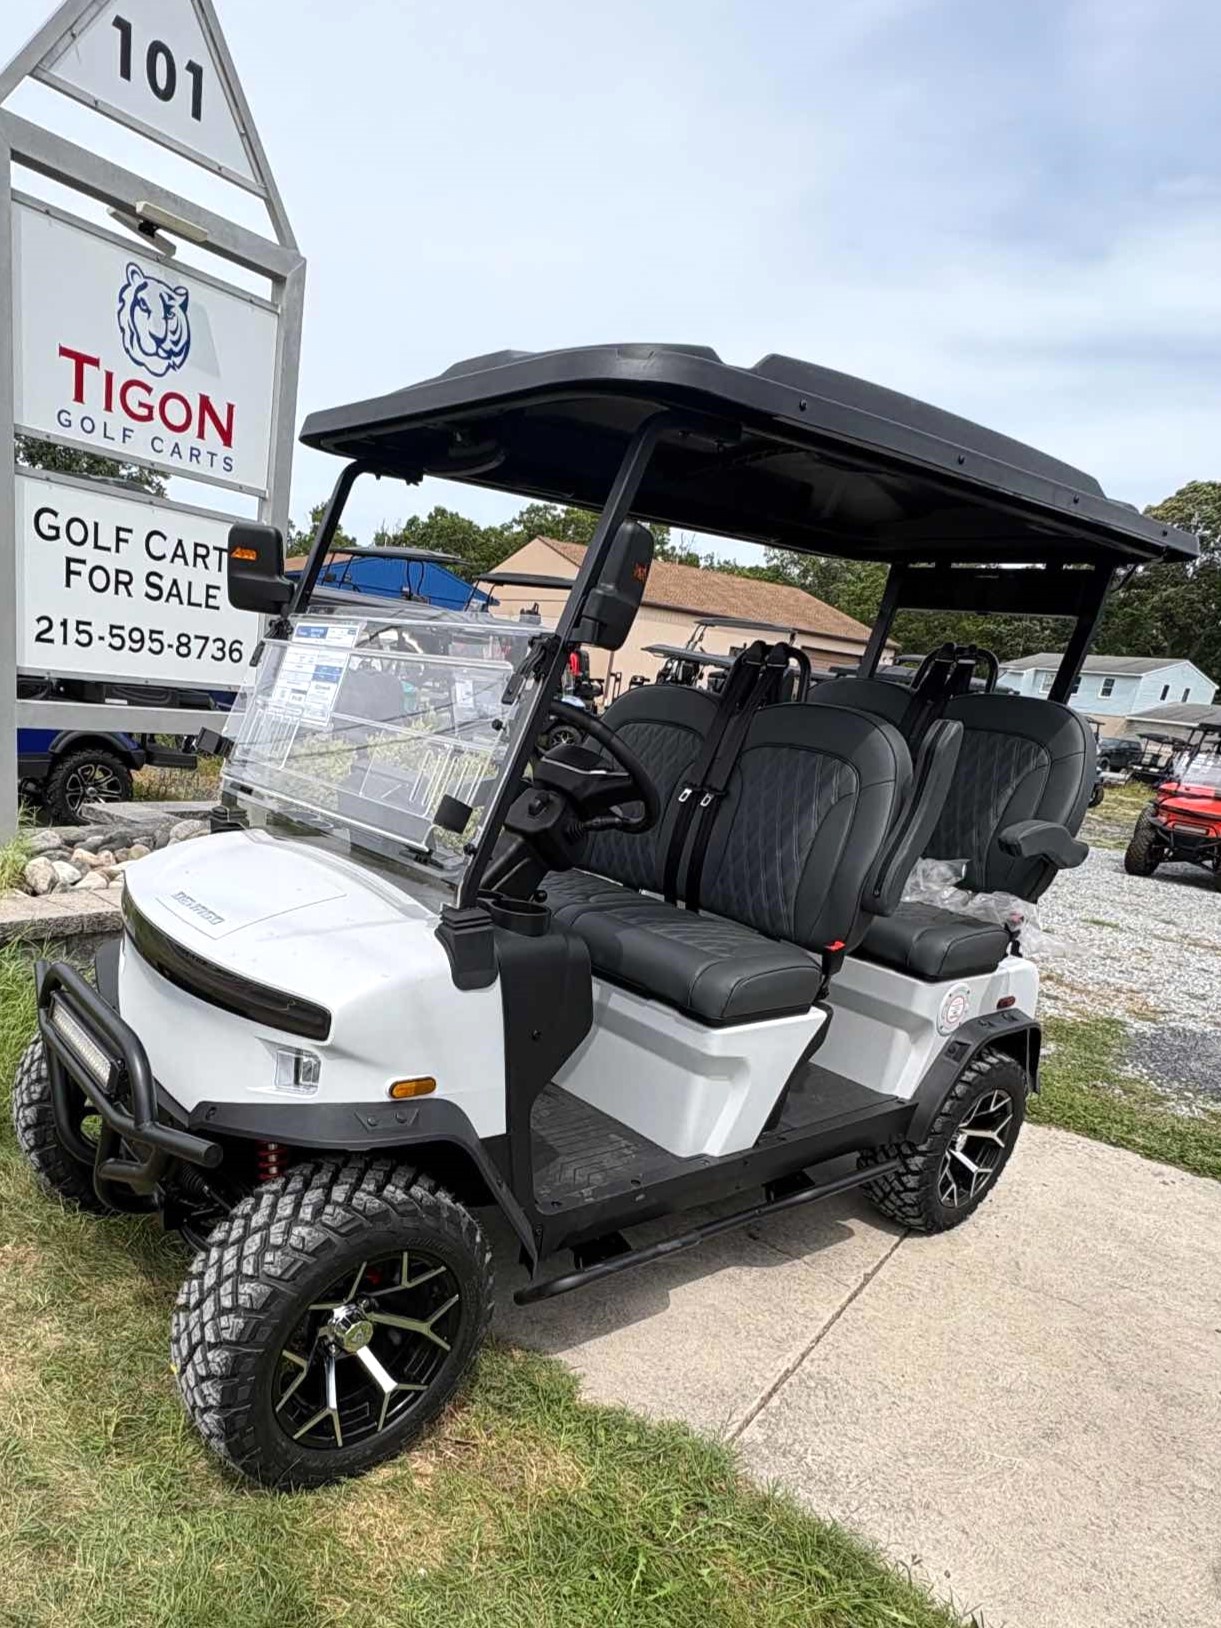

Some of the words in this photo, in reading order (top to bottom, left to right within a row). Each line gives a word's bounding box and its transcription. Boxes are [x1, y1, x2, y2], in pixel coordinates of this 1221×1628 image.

[112, 14, 203, 121] 101
[58, 345, 235, 448] TIGON
[57, 409, 134, 443] GOLF
[151, 436, 233, 473] CARTS
[33, 507, 133, 554] GOLF
[144, 530, 229, 573] CART
[64, 556, 133, 598] FOR
[144, 571, 221, 611] SALE
[34, 615, 243, 664] 215-595-8736
